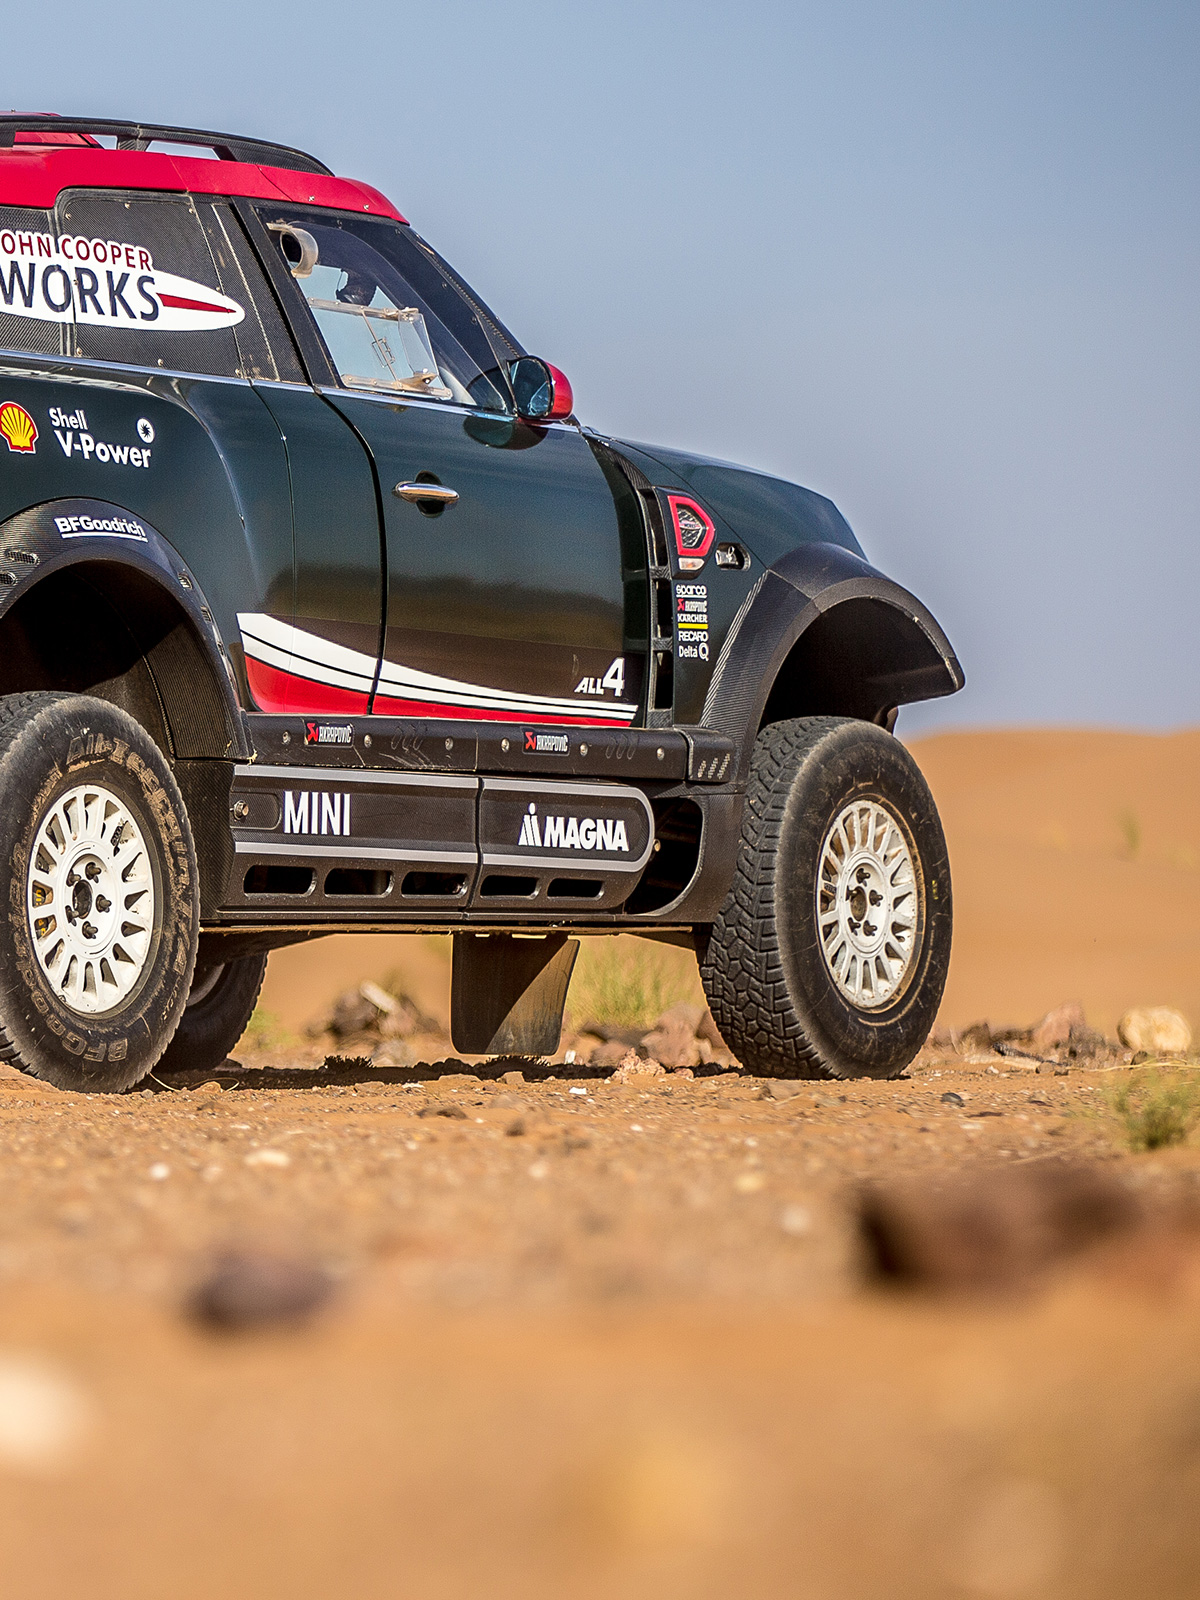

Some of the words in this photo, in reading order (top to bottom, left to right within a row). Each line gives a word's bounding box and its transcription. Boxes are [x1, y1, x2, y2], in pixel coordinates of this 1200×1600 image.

[61, 237, 152, 272] COOPER
[49, 407, 88, 430] Shell
[54, 429, 152, 468] V-Power
[54, 515, 146, 537] BFGoodrich
[676, 584, 707, 596] sparco
[678, 630, 709, 642] RECARO
[283, 790, 351, 836] MINI
[543, 815, 630, 851] MAGNA
